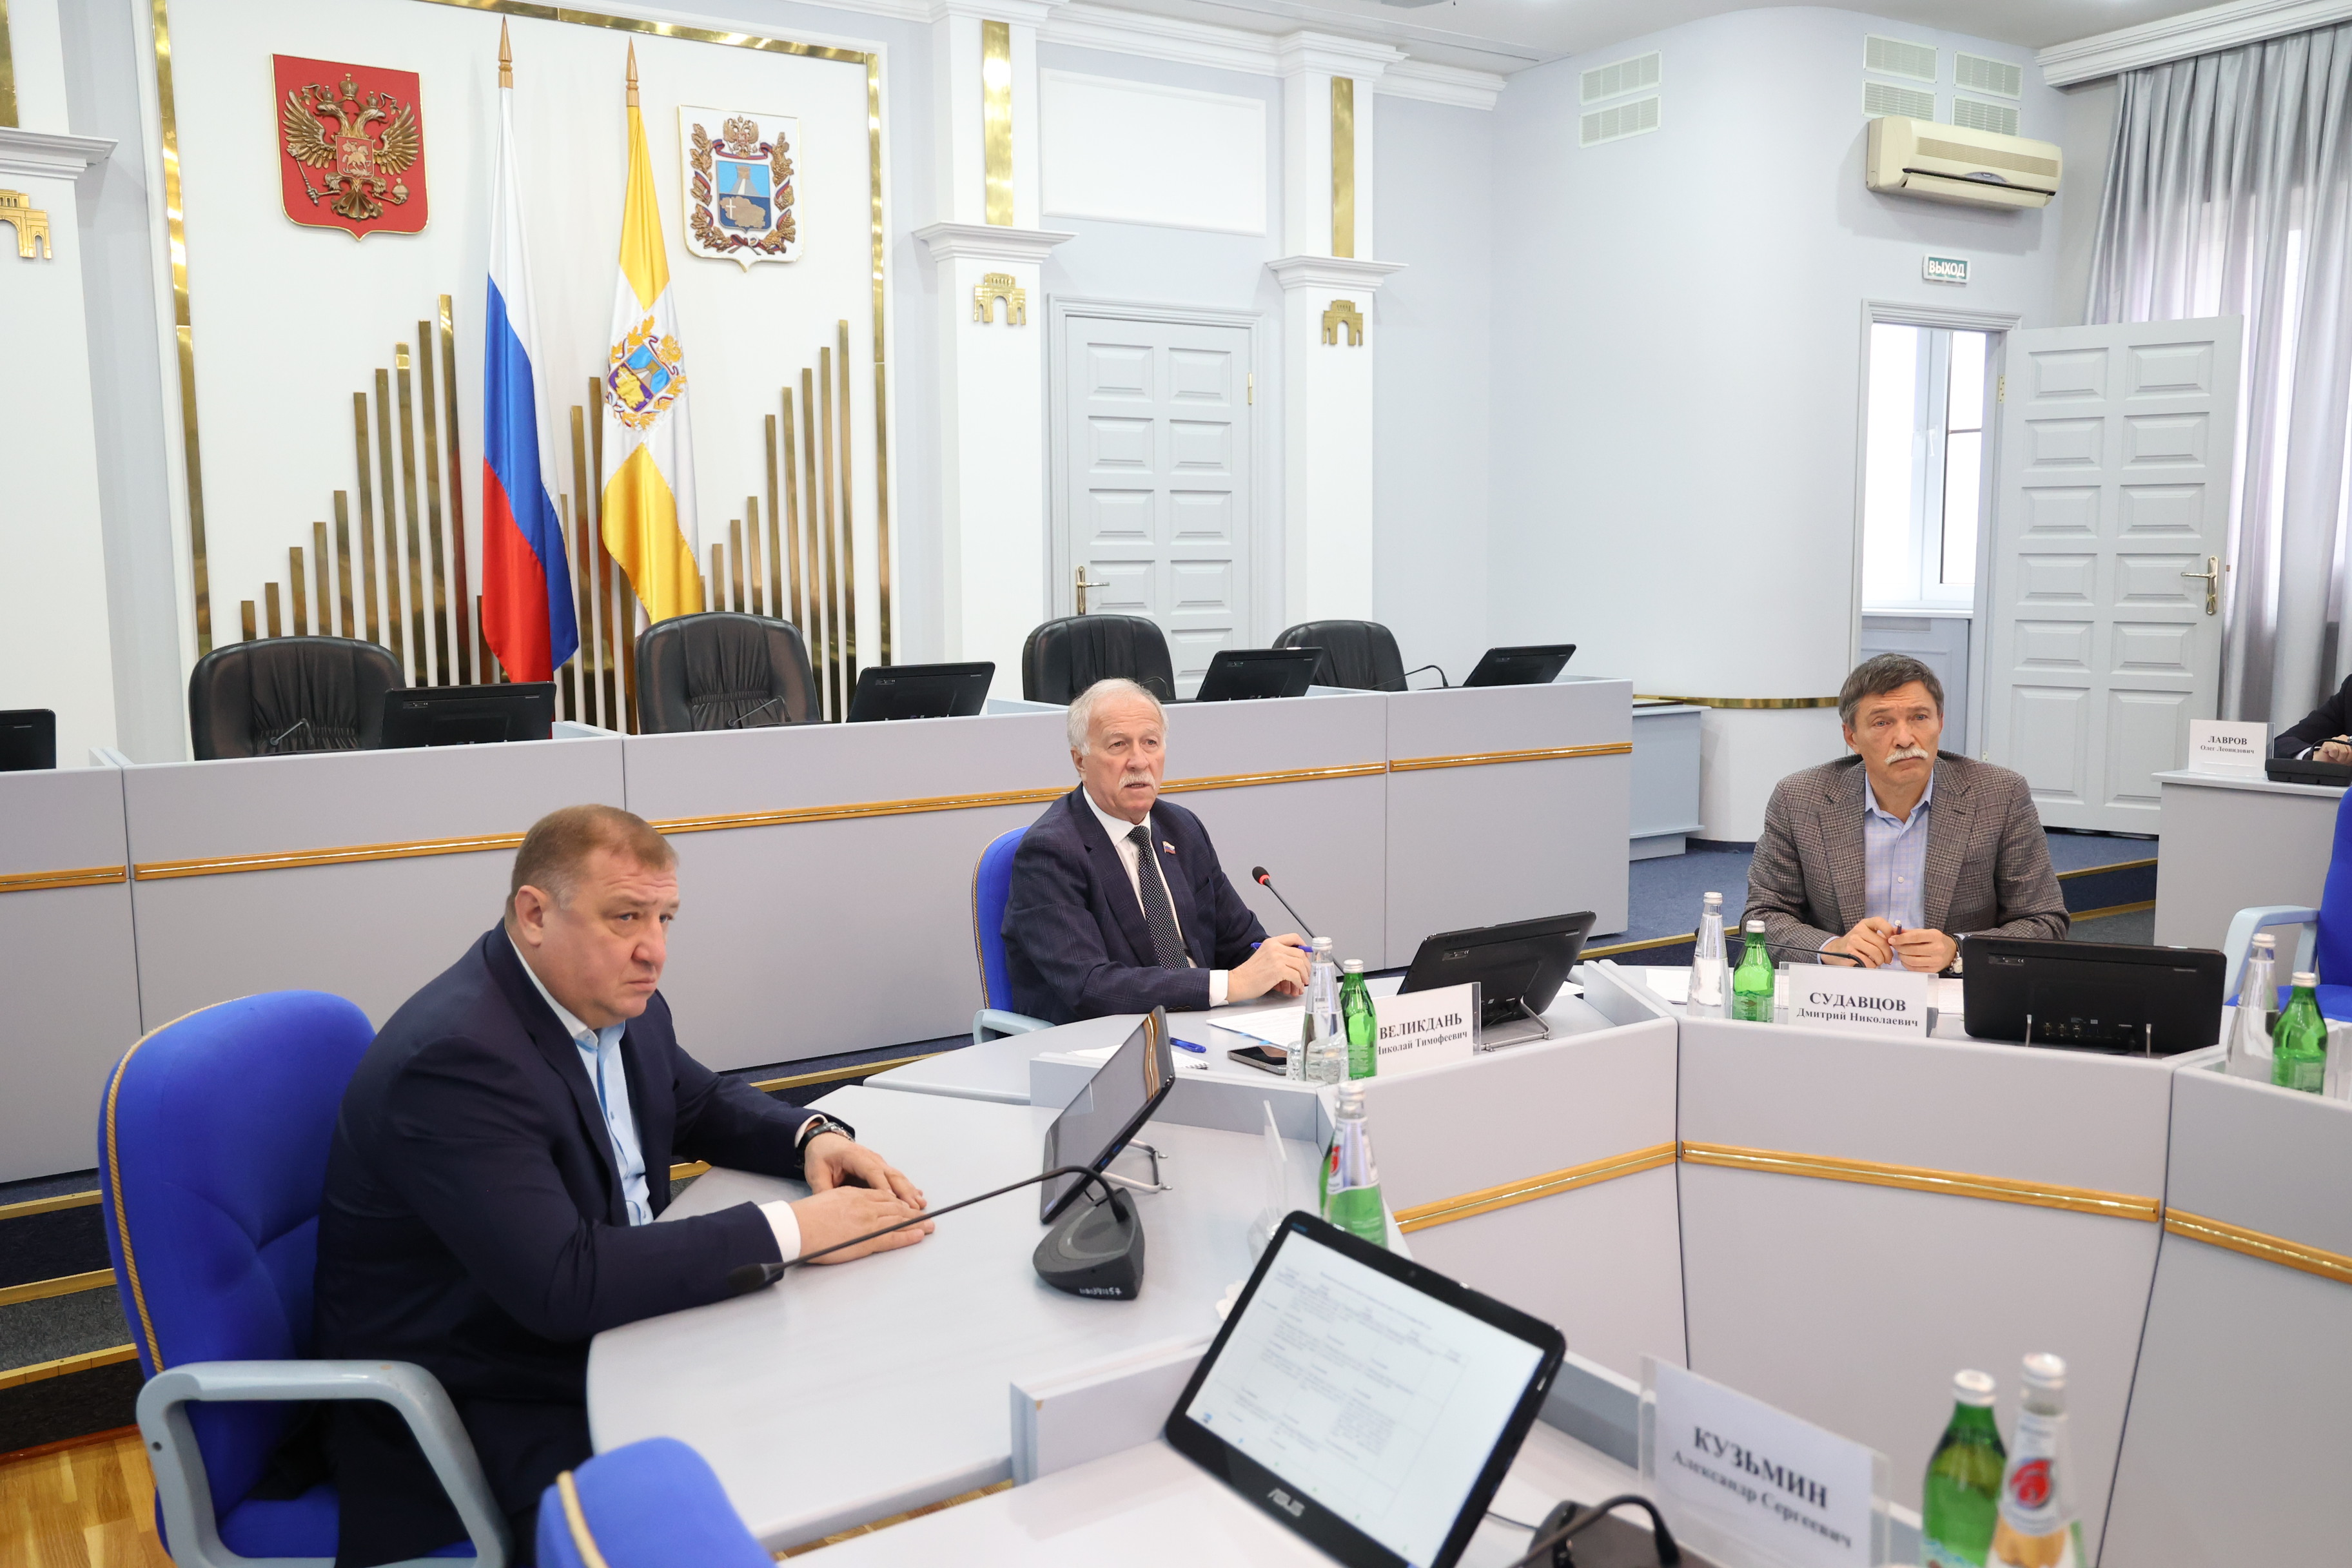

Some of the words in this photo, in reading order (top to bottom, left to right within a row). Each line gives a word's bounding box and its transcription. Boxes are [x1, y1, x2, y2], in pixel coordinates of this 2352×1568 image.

[1929, 260, 1965, 277] ВЫХОД
[2208, 736, 2247, 745] ЛАВРОВ
[1809, 992, 1906, 1012] СУДАВЦОВ
[1380, 1013, 1462, 1039] ВЕЛИКДАНЬ
[1797, 1008, 1847, 1021] Дмитрий
[1850, 1013, 1918, 1027] Николаевич
[1415, 1031, 1467, 1048] Тимофеевич
[1694, 1426, 1828, 1509] КУЗЬМИН
[1673, 1449, 1758, 1504] Александр
[1761, 1491, 1852, 1548] Сергеевич
